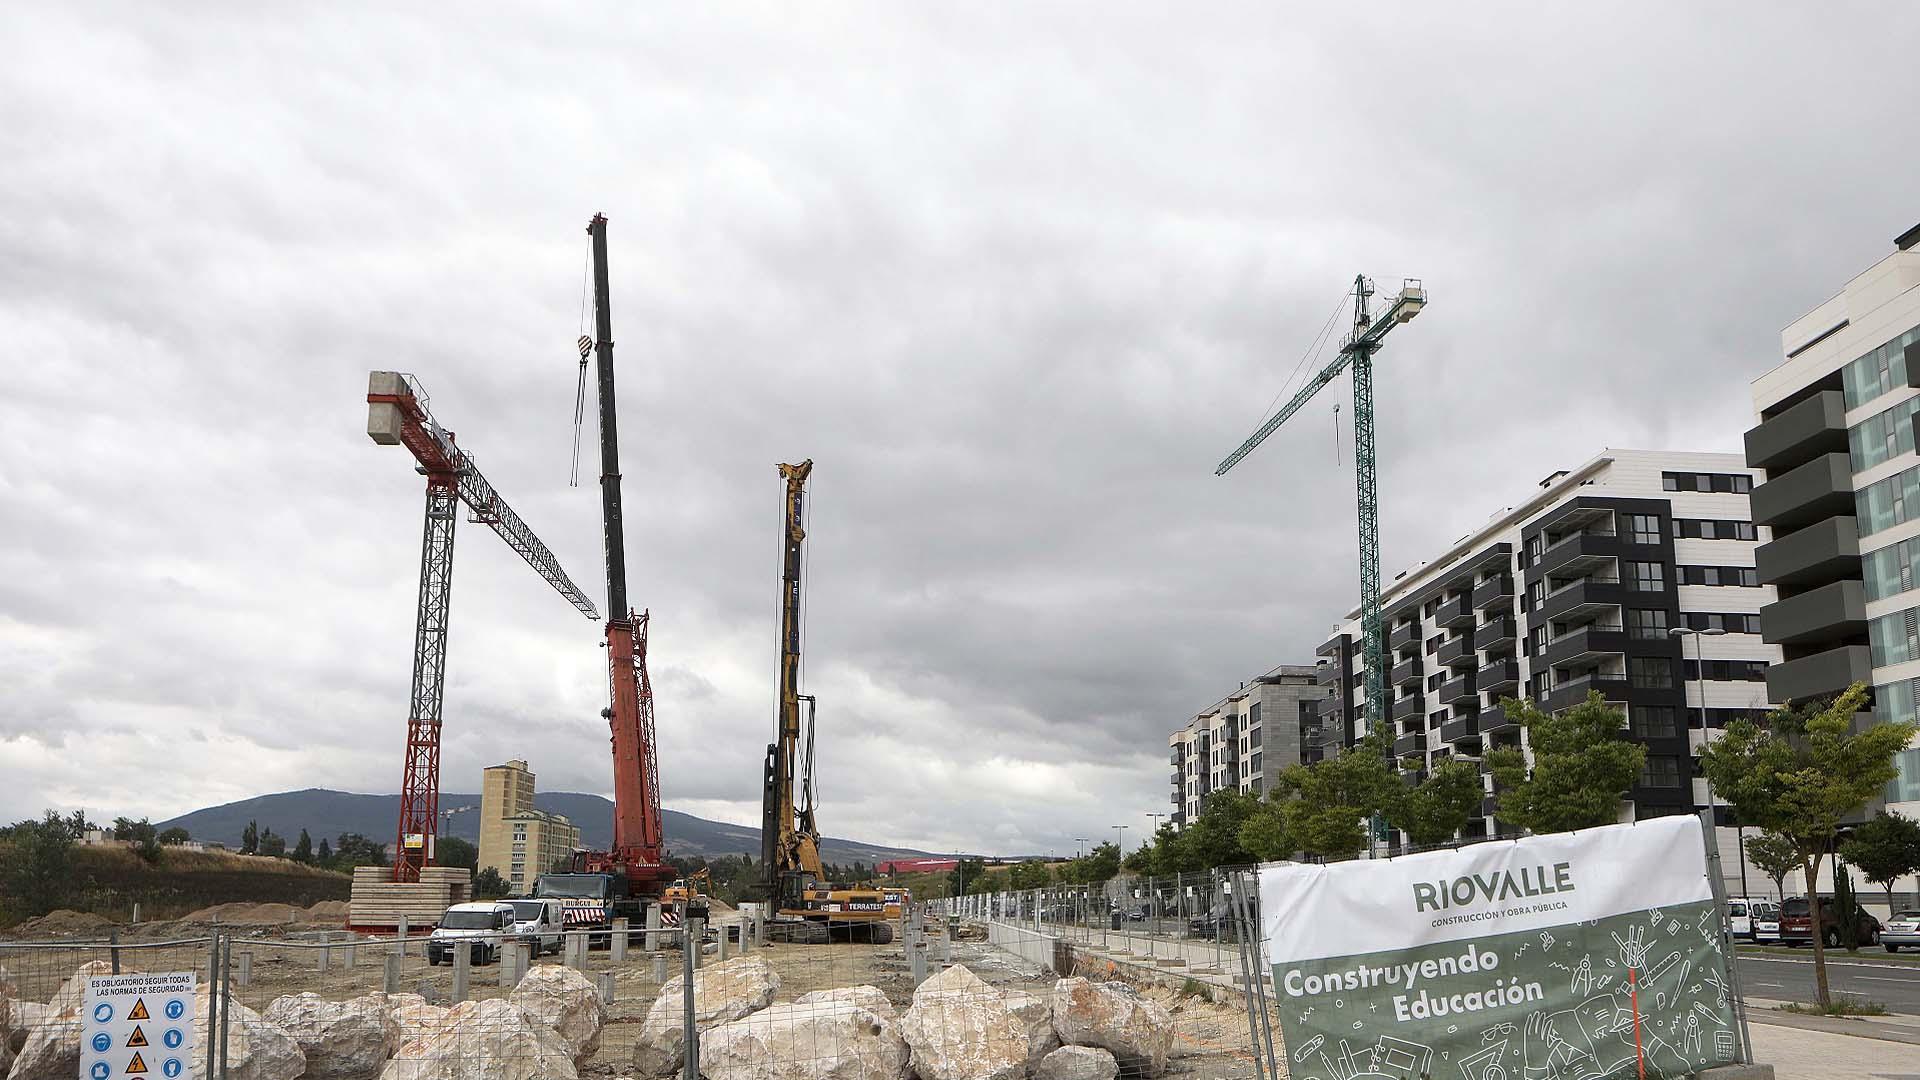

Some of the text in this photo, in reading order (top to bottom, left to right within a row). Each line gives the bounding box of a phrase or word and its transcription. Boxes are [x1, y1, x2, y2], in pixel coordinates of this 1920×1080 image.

[1412, 862, 1575, 913] RIOVALLE
[1431, 902, 1568, 928] CONSTRUCCIÓN Y OBRA PÚBLICA
[101, 979, 143, 987] OBLIGATORIO
[144, 977, 168, 985] SEGUIR
[168, 976, 190, 984] TODAS
[1284, 944, 1499, 998] Construyendo
[96, 989, 109, 997] LAS
[110, 987, 139, 995] NORMAS
[148, 985, 184, 994] SEGURIDAD
[1393, 977, 1544, 1022] Educación
